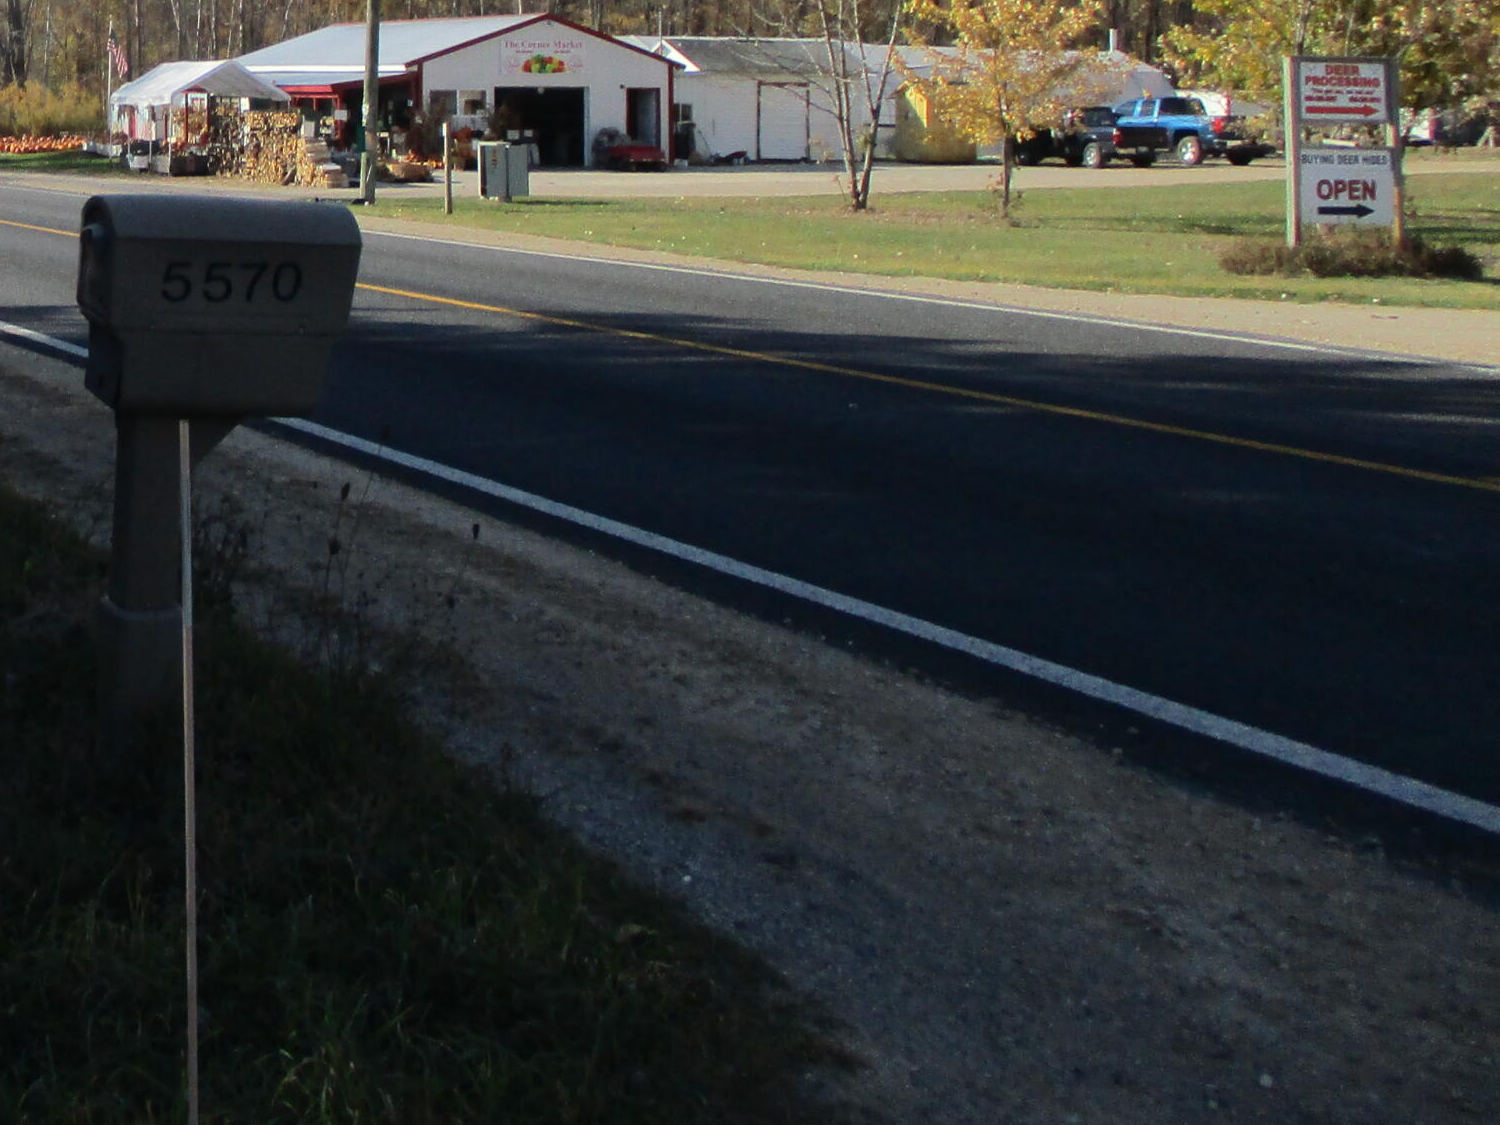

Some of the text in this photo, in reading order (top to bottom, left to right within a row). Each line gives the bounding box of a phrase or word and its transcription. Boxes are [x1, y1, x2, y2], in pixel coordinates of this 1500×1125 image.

[504, 40, 518, 49] The
[553, 40, 583, 49] Market
[1325, 65, 1359, 75] DEER
[1304, 75, 1381, 87] PROCESSING
[1301, 154, 1388, 165] BUYING DEER HIDES
[1316, 179, 1377, 201] OPEN
[161, 260, 303, 303] 5570
